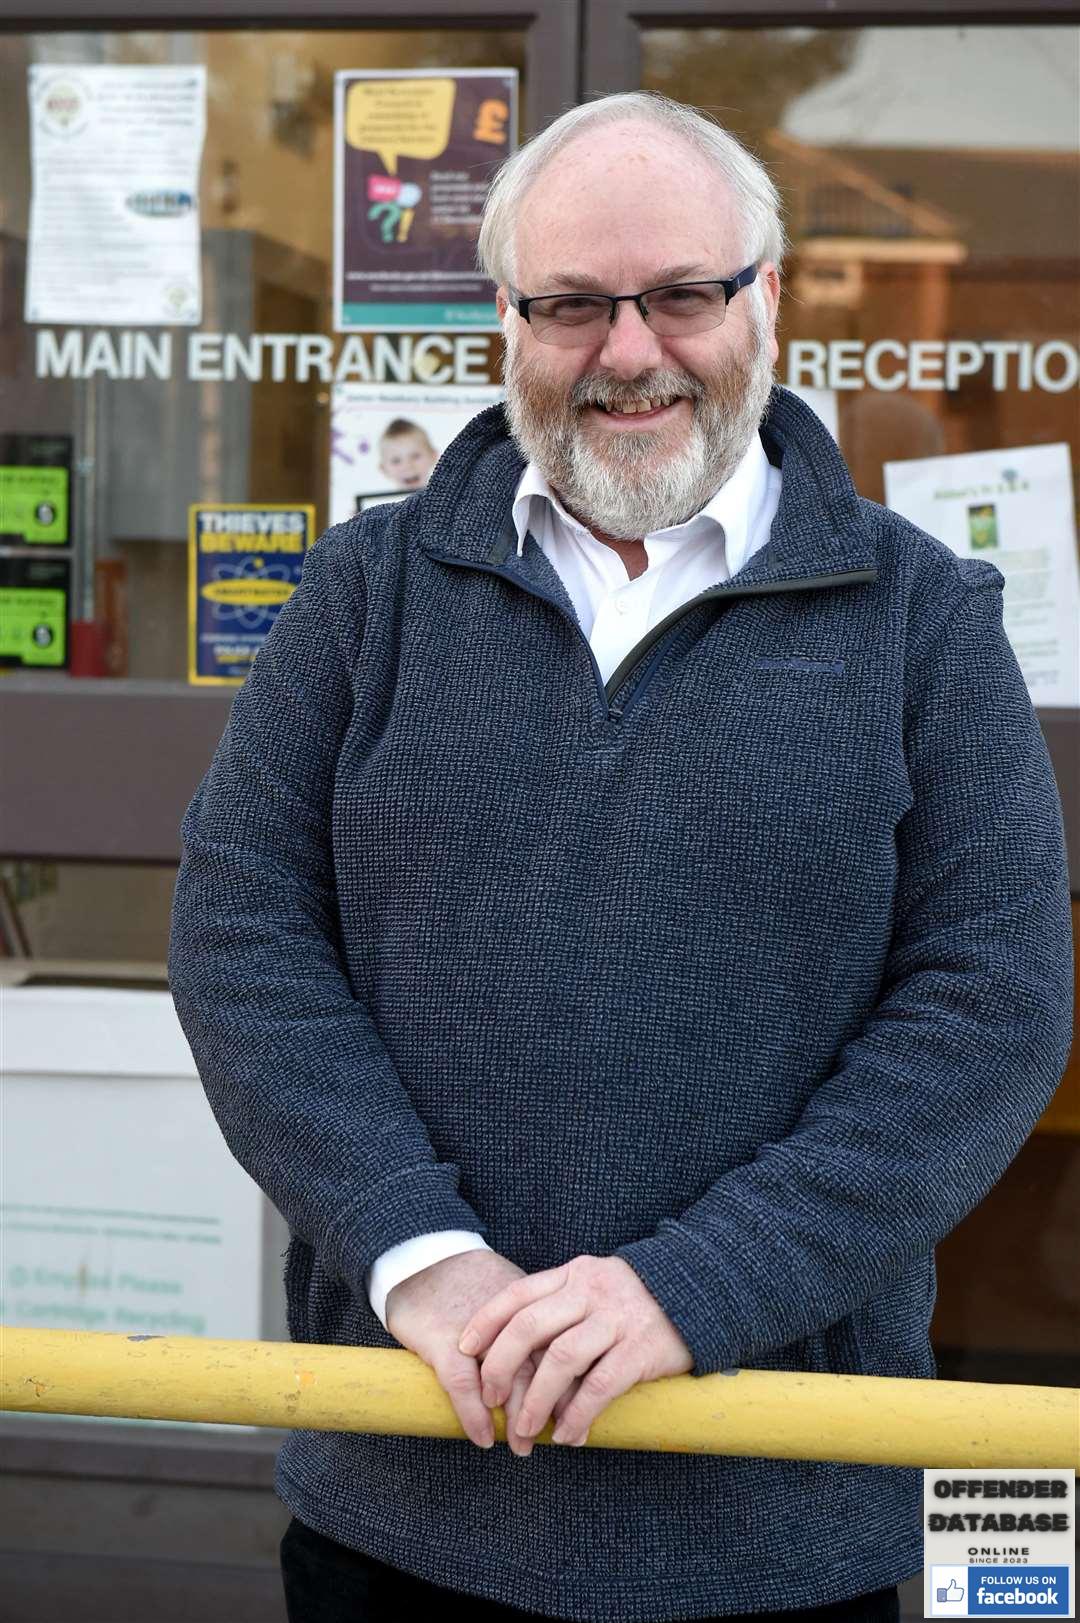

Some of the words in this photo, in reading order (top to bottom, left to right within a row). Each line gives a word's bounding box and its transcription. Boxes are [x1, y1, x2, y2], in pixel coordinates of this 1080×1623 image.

[36, 329, 171, 379] MAIN
[188, 333, 491, 383] ENTRANCE
[787, 339, 1080, 393] RECEPTIO
[201, 512, 305, 533] THIEVES
[201, 532, 304, 553] BEWARE
